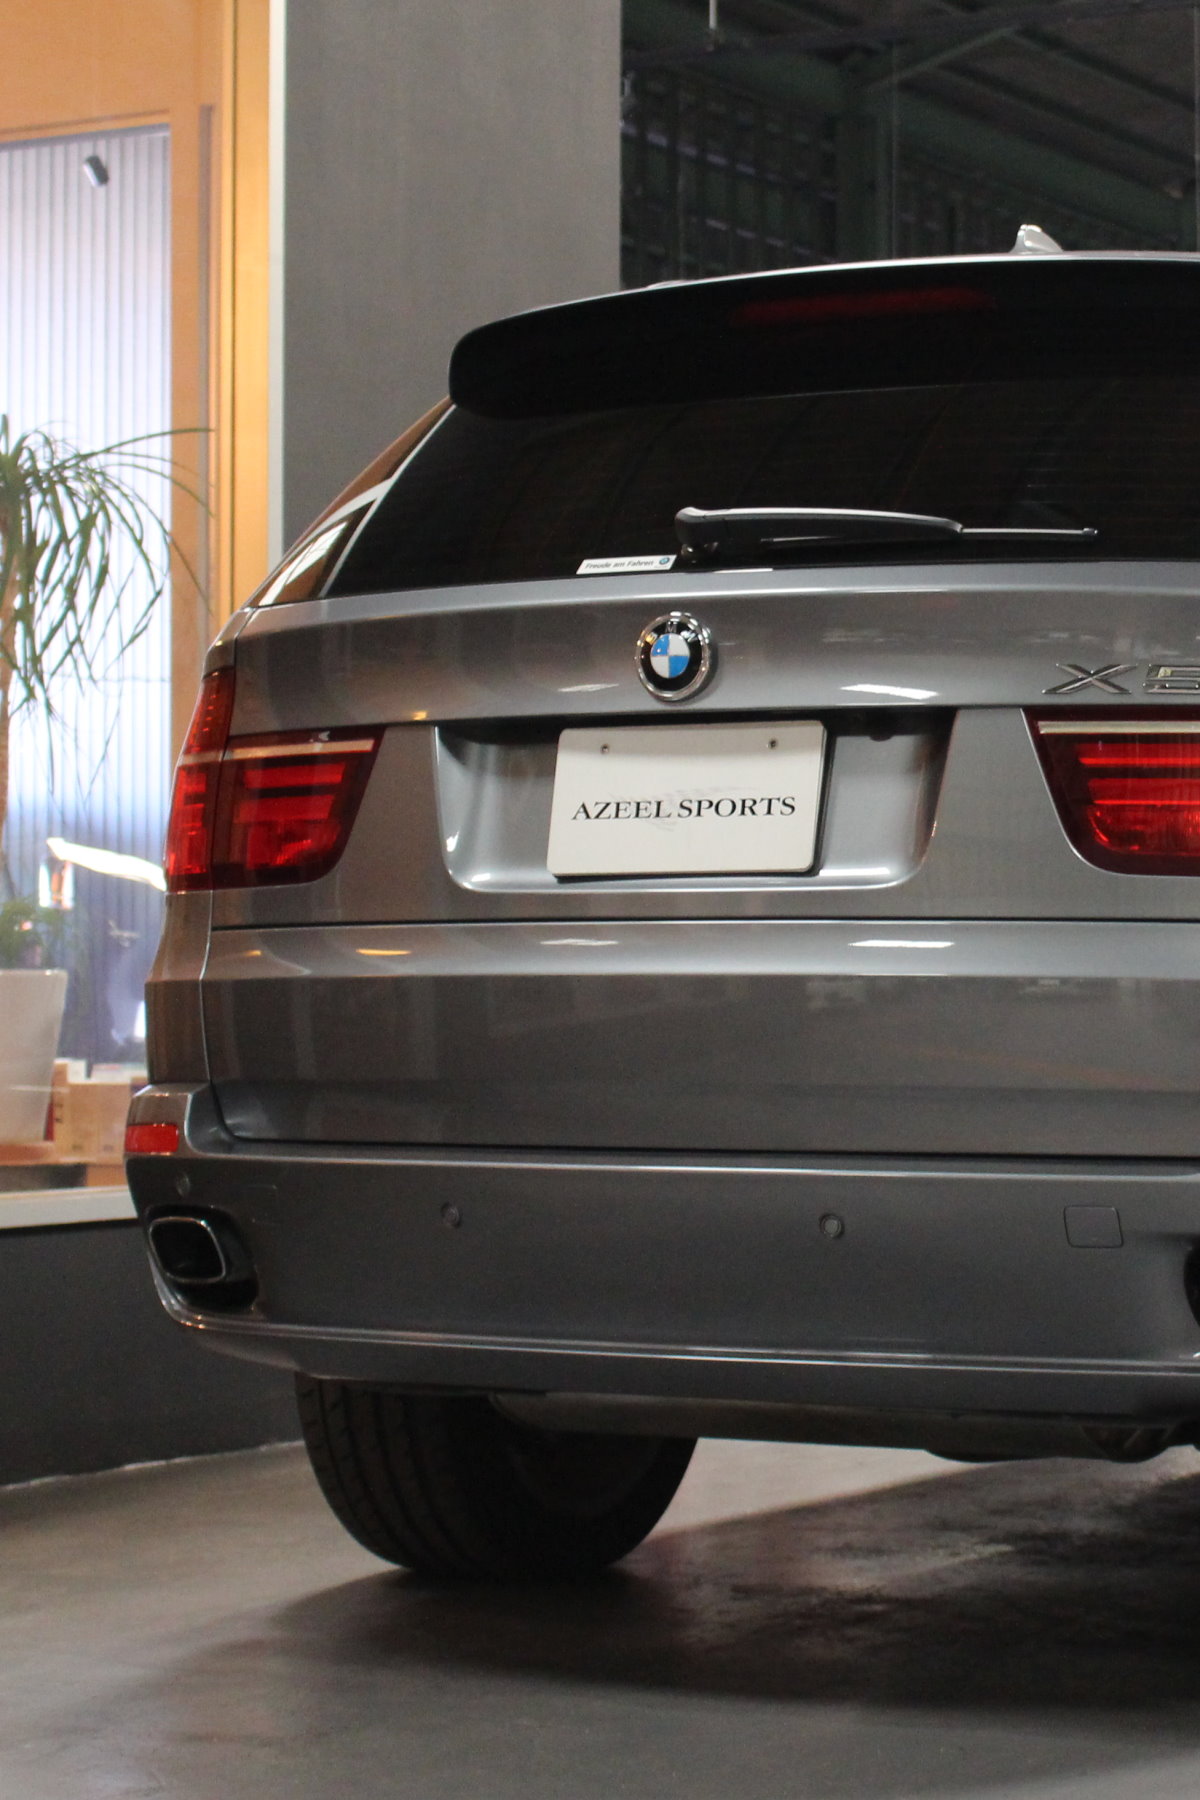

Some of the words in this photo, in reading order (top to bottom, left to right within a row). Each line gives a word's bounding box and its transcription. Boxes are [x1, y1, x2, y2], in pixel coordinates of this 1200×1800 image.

[645, 620, 698, 645] BMW
[571, 800, 673, 821] AZEEL
[676, 796, 796, 819] SPORTS
